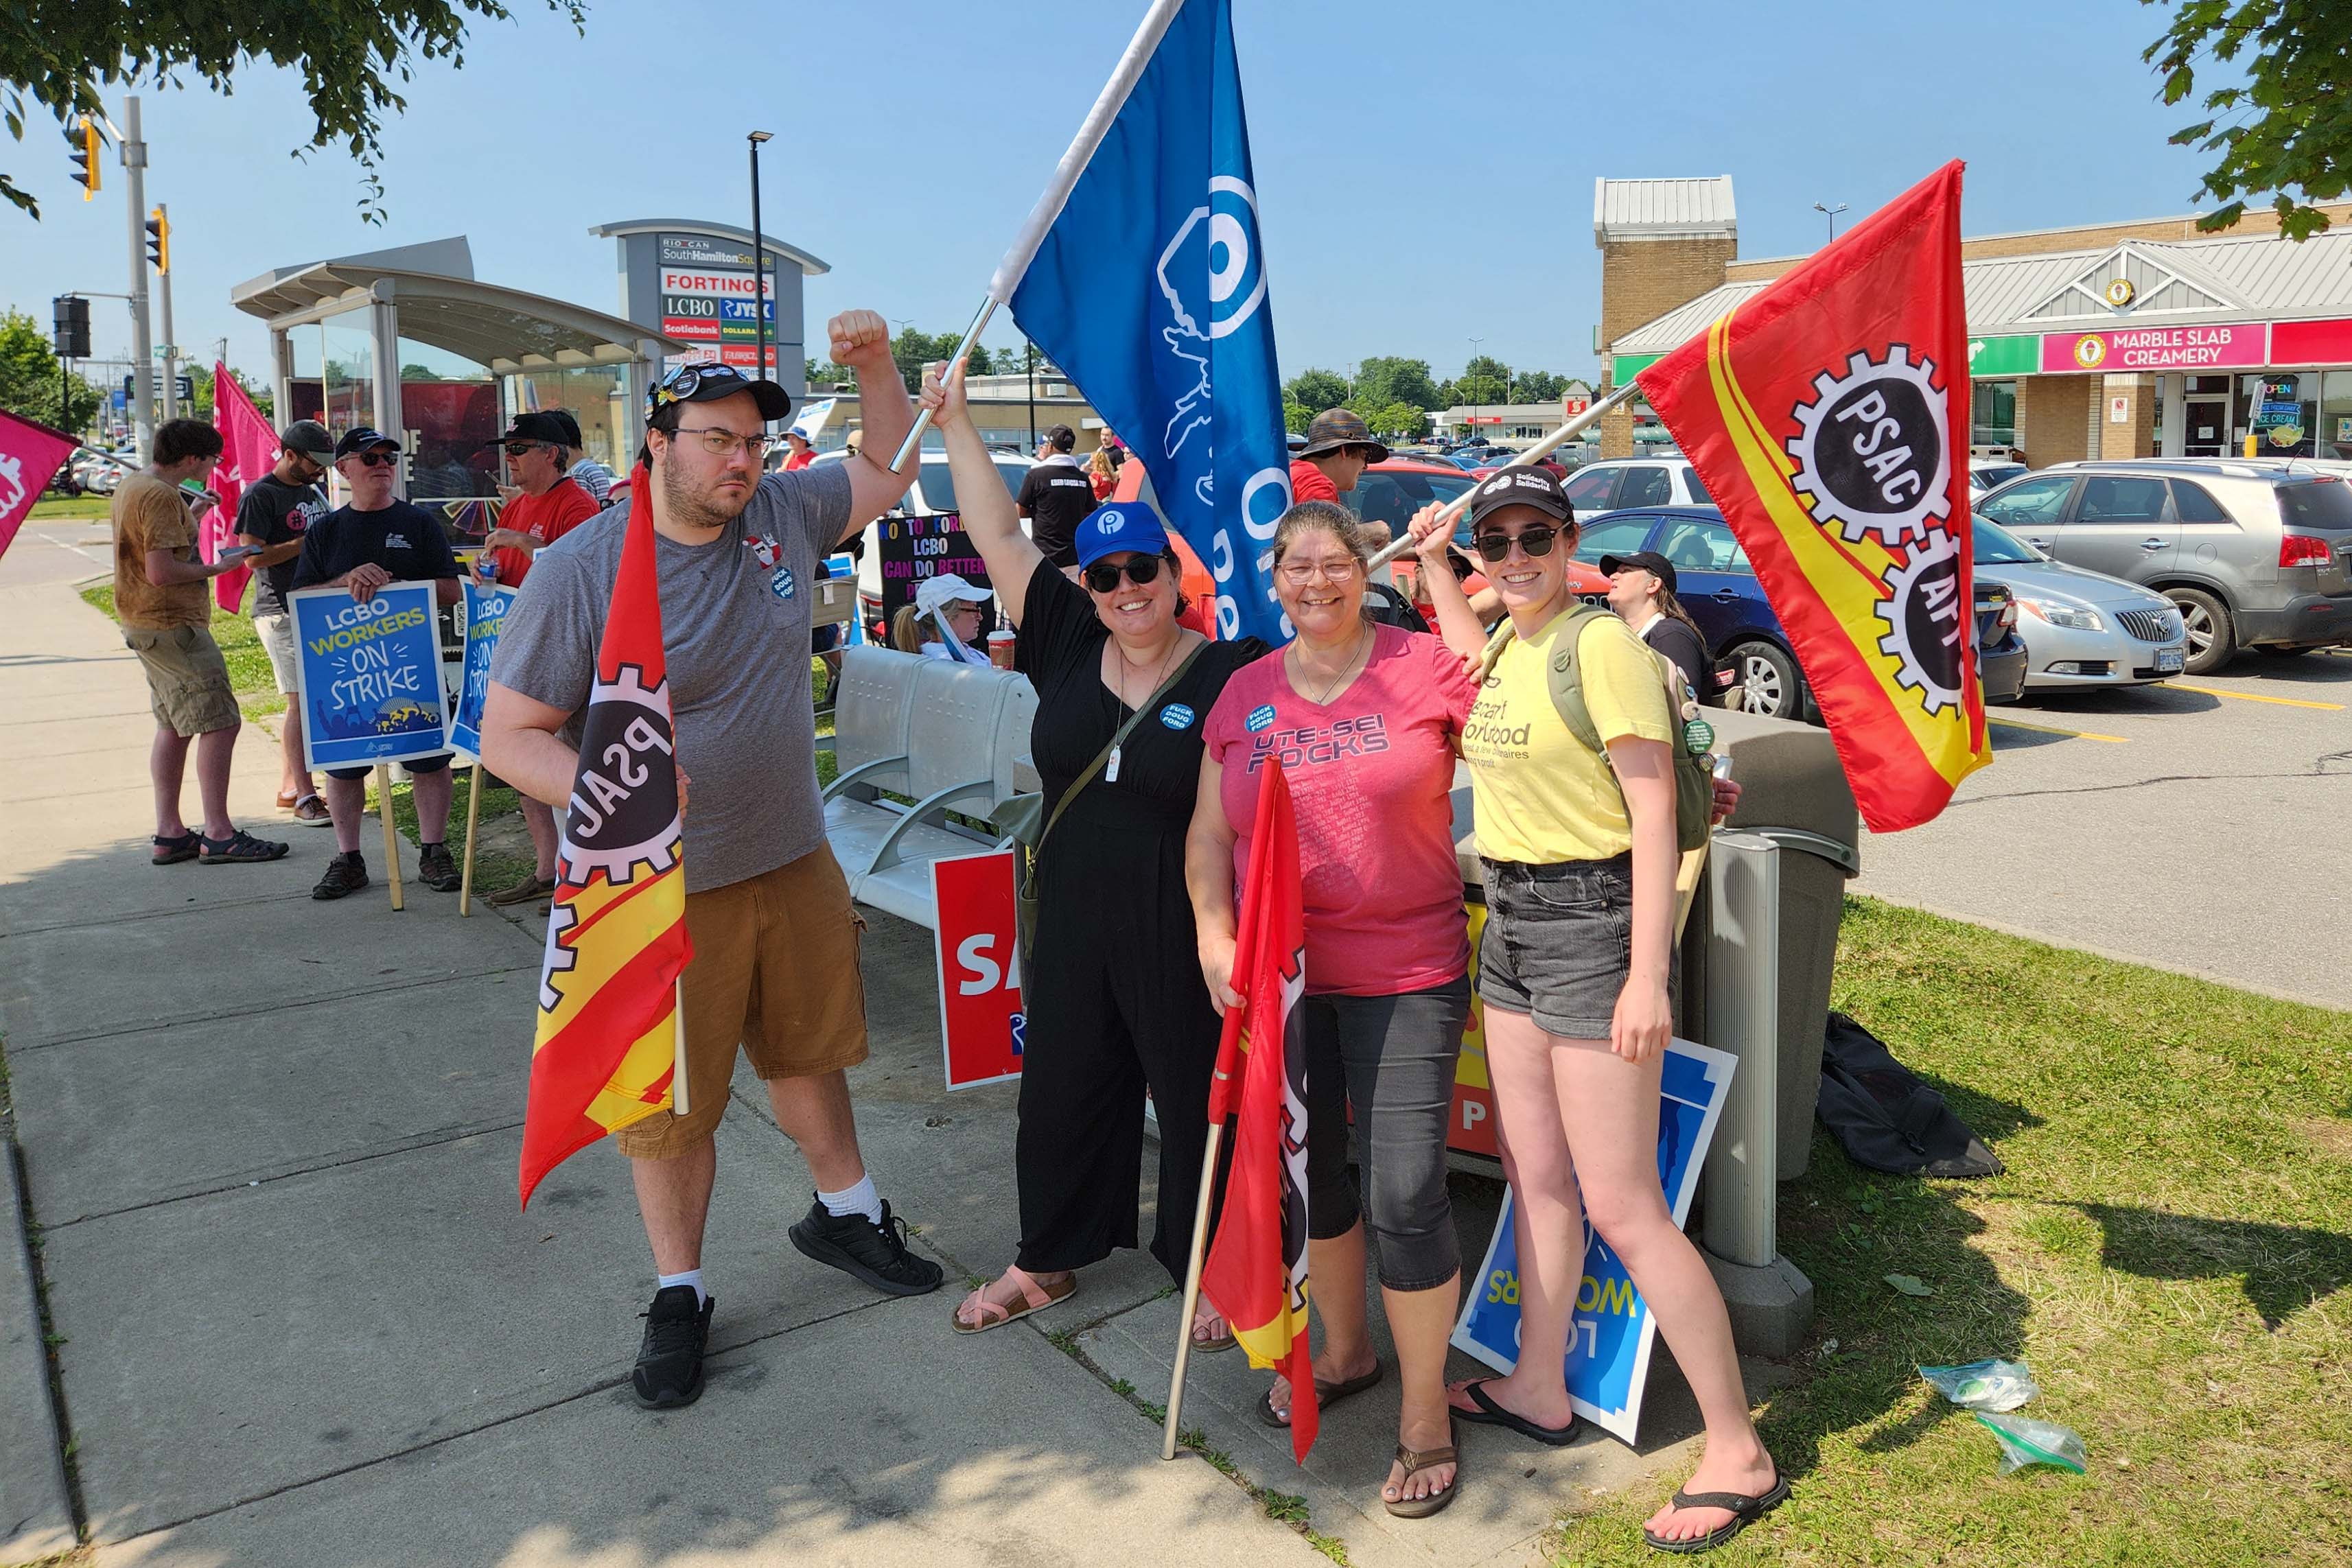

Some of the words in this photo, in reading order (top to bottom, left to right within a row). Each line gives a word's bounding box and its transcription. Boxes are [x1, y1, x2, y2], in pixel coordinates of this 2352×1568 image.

[668, 298, 714, 316] LCBO
[664, 325, 719, 335] Scotiabank
[2113, 332, 2184, 349] MARBLE
[2187, 329, 2232, 347] SLAB
[2123, 347, 2222, 365] CREAMERY
[2266, 384, 2291, 394] OPEN
[2271, 414, 2295, 423] CREAM
[1835, 389, 1921, 504] PSAC
[879, 522, 898, 540] NO
[906, 518, 924, 536] TO
[913, 537, 948, 556] LCBO
[771, 568, 788, 583] FUCK
[883, 561, 912, 578] CAN
[915, 560, 934, 577] DO
[938, 558, 986, 576] BETTER
[774, 576, 793, 591] DOUG
[325, 598, 390, 631] LCBO
[477, 598, 505, 620] LCBO
[309, 607, 426, 656] WORKERS
[469, 618, 505, 641] WORKE
[351, 641, 389, 673] ON
[331, 665, 420, 710] STRIKE
[468, 668, 487, 700] STRI
[1165, 711, 1189, 723] DOUG
[1169, 705, 1193, 717] FUCK
[1249, 705, 1271, 721] FUCK
[1250, 712, 1272, 726] DOUG
[1163, 716, 1185, 728] FORD
[1251, 718, 1273, 732] FORD
[1254, 713, 1385, 751] UTE-SEI
[1487, 1269, 1637, 1318] WORS
